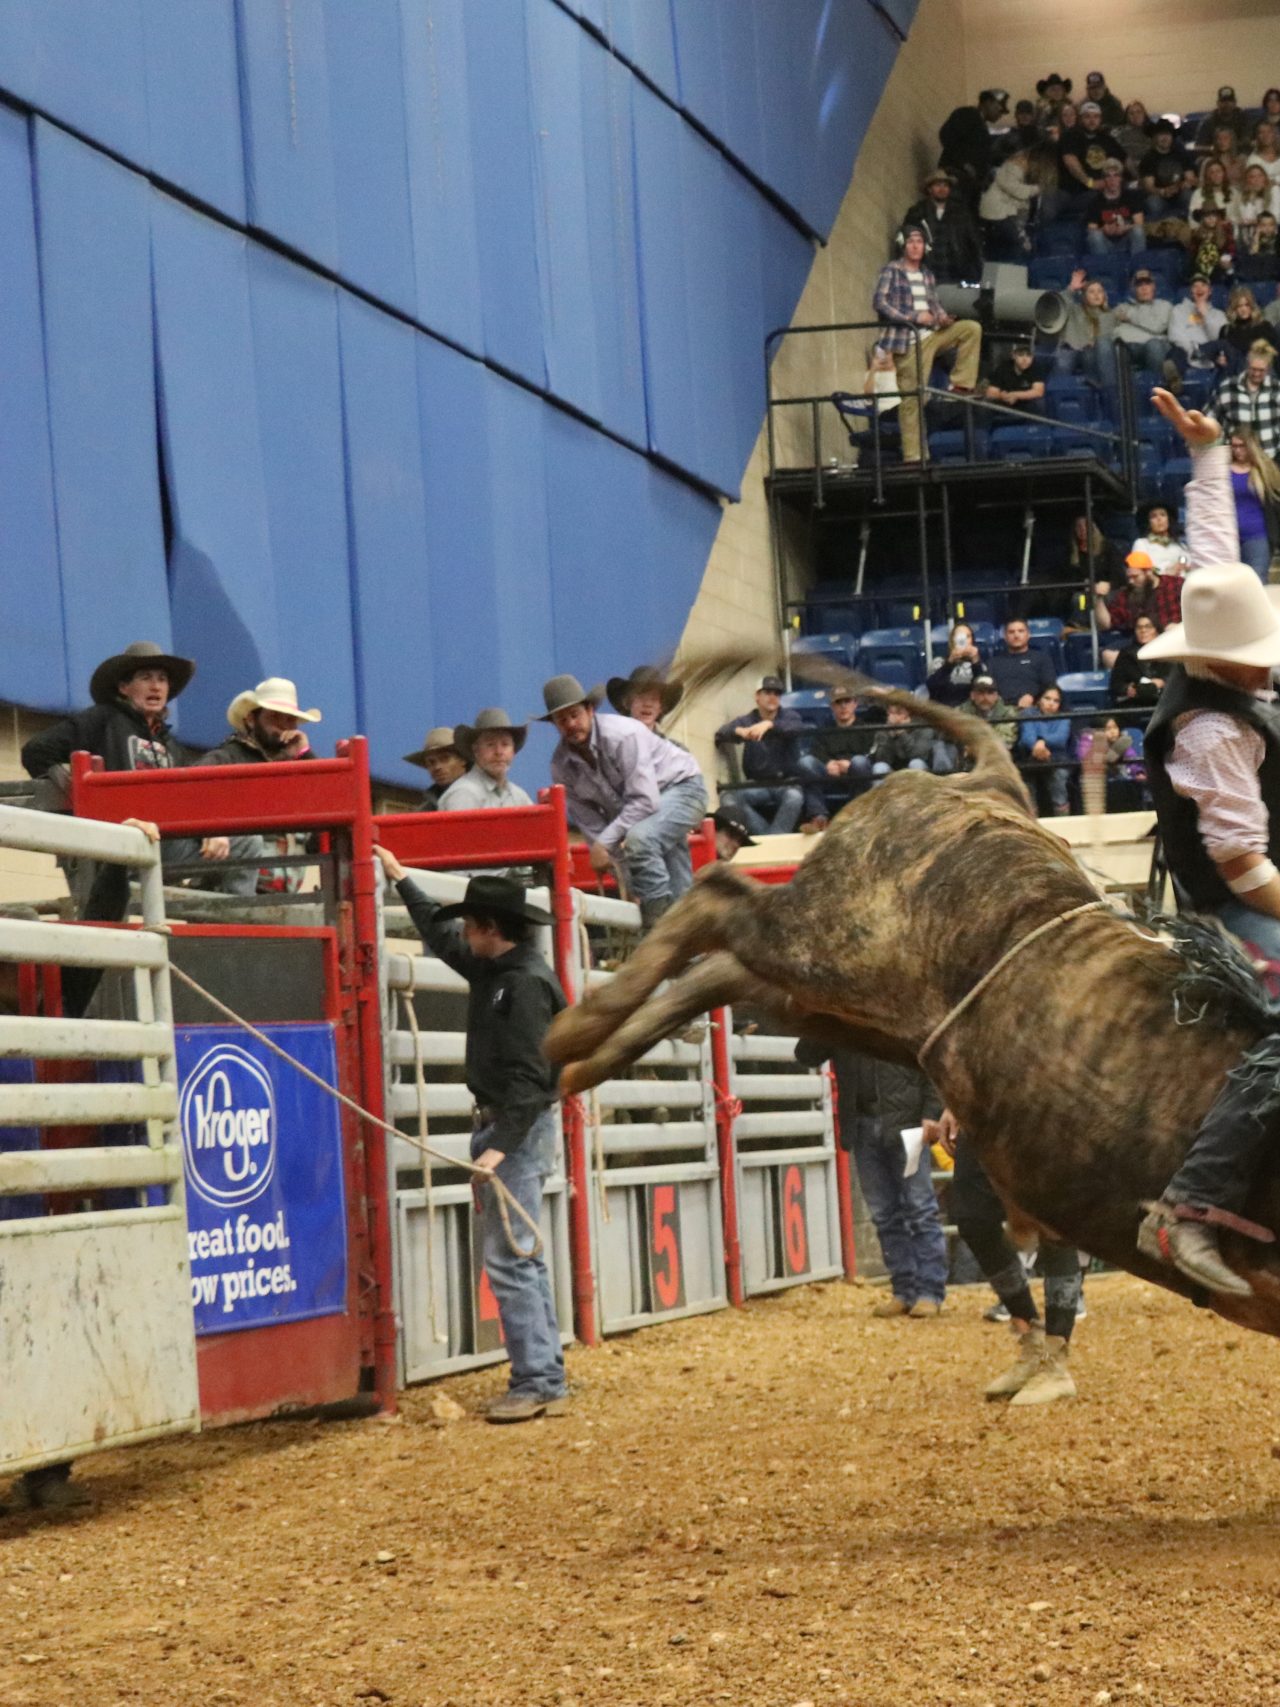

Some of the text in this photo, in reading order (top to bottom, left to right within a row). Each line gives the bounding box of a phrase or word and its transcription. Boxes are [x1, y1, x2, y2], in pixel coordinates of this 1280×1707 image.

[195, 1070, 271, 1182] Kroger
[187, 1210, 291, 1260] reat food.
[653, 1185, 681, 1308] 5
[783, 1164, 807, 1274] 6
[190, 1257, 298, 1313] ow prices.
